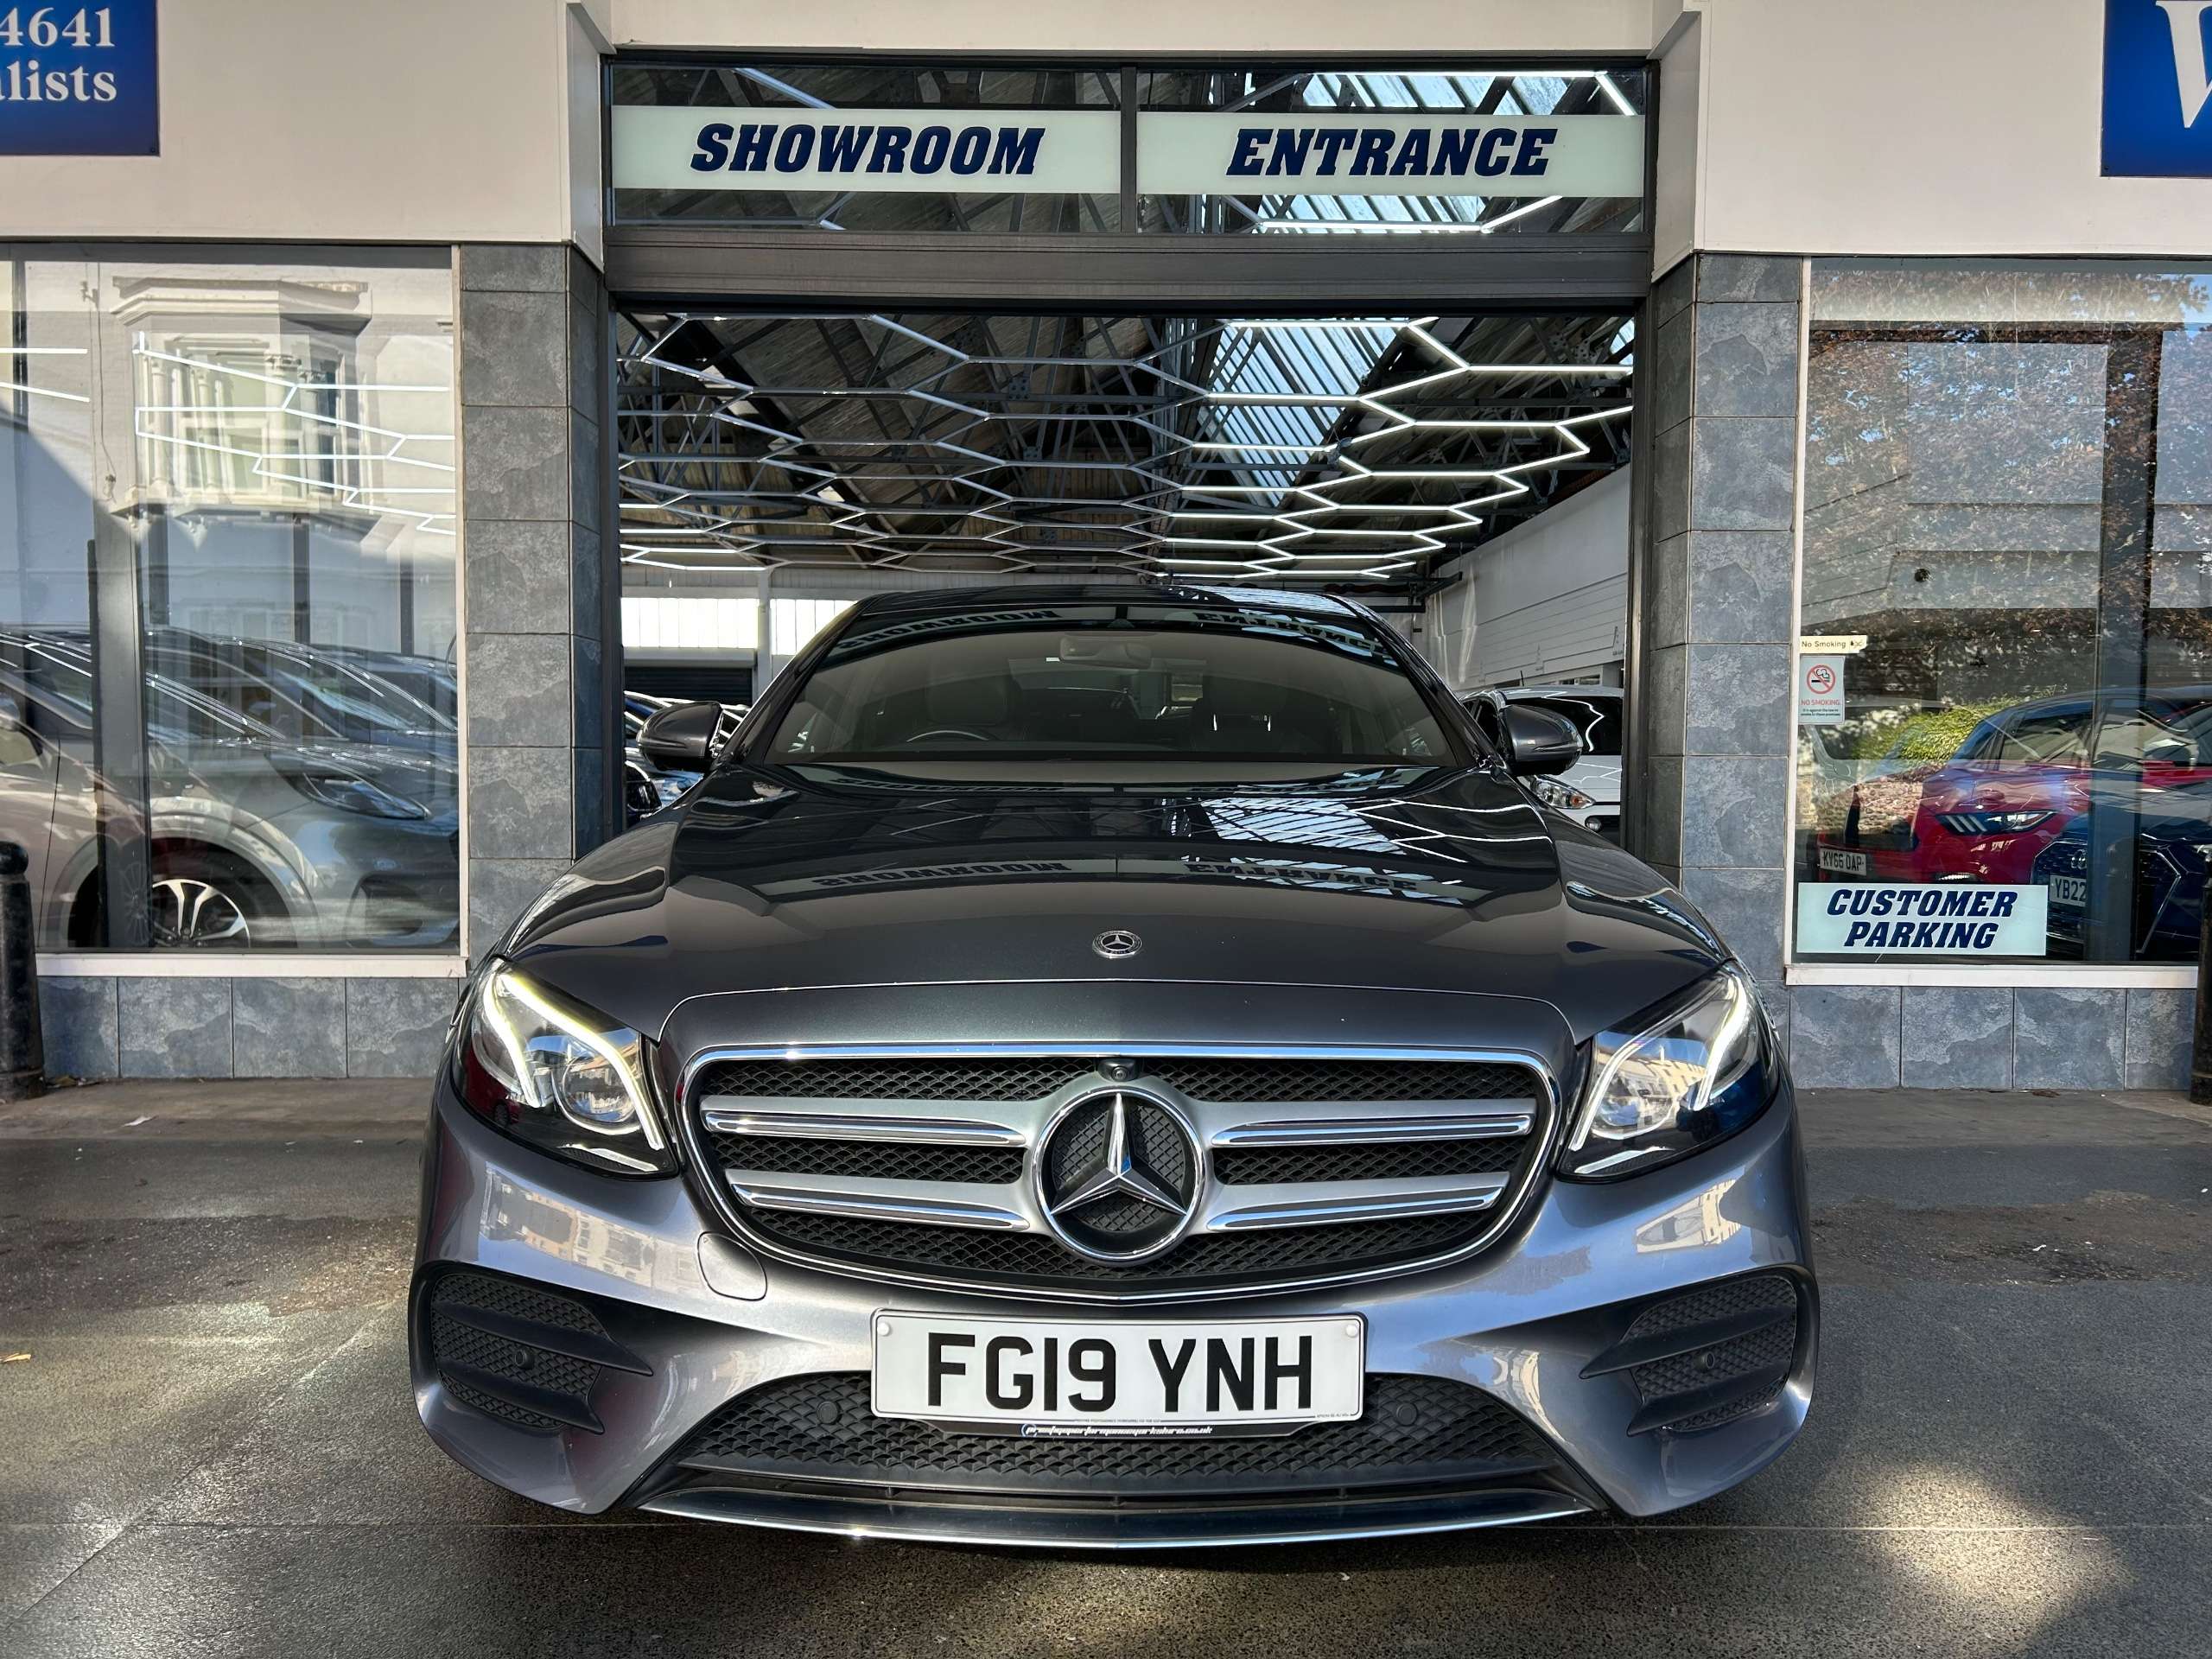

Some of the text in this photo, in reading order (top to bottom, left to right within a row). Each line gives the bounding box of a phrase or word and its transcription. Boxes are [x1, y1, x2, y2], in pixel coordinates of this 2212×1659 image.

[0, 7, 116, 48] 4641
[0, 60, 118, 102] lists
[691, 123, 1045, 175] SHOWROOM
[1225, 128, 1558, 177] ENTRANCE
[1827, 889, 2018, 918] CUSTOMER
[2055, 878, 2087, 902] YB22
[1844, 921, 1999, 950] PARKING
[927, 1332, 1313, 1413] FG19 YNH
